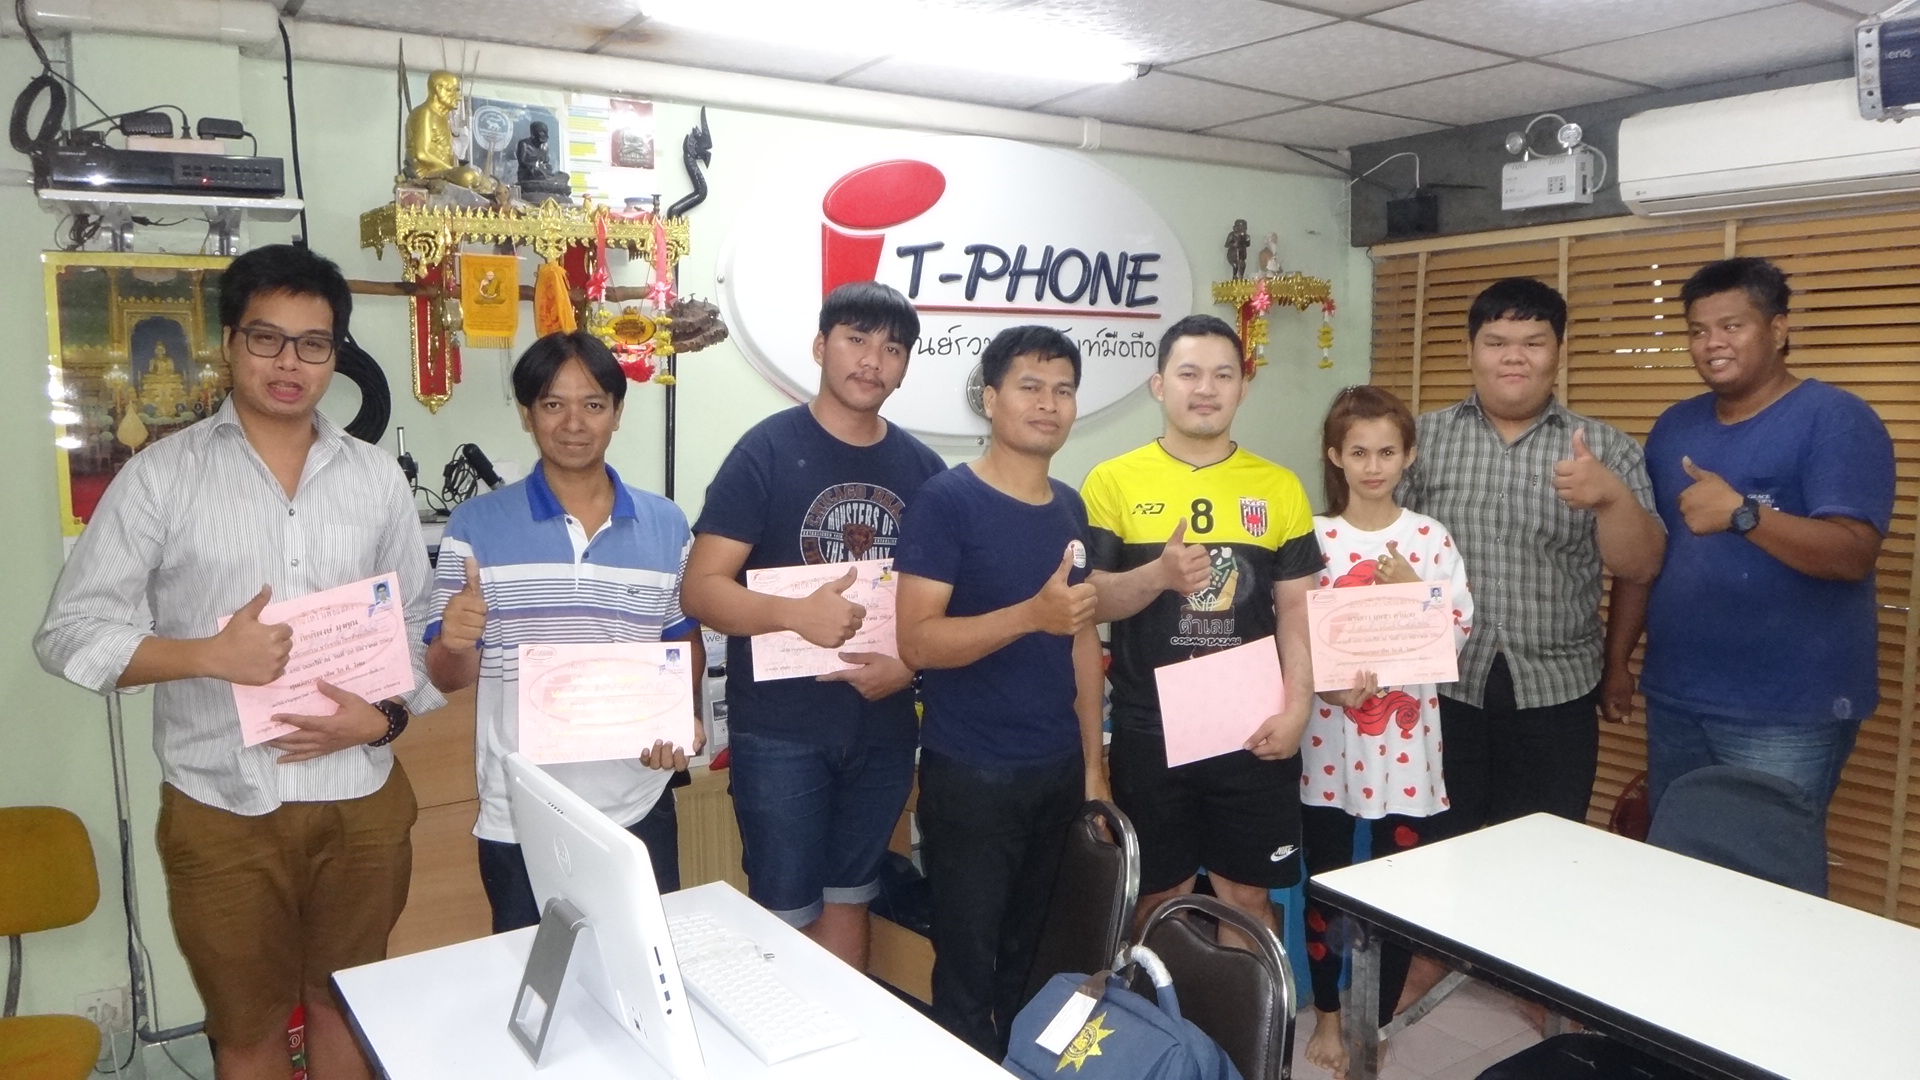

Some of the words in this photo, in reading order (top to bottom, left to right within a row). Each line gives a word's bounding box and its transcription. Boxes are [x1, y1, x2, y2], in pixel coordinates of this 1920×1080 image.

[896, 241, 1161, 308] T-PHONE
[806, 484, 867, 527] CHICAGO
[871, 487, 905, 523] BEA
[827, 502, 880, 533] MONSTERS
[882, 513, 894, 536] OF
[1191, 498, 1214, 534] 8
[826, 540, 844, 563] THE
[704, 632, 723, 643] Wel
[1170, 636, 1206, 646] COSMO
[1275, 844, 1294, 856] NIKE
